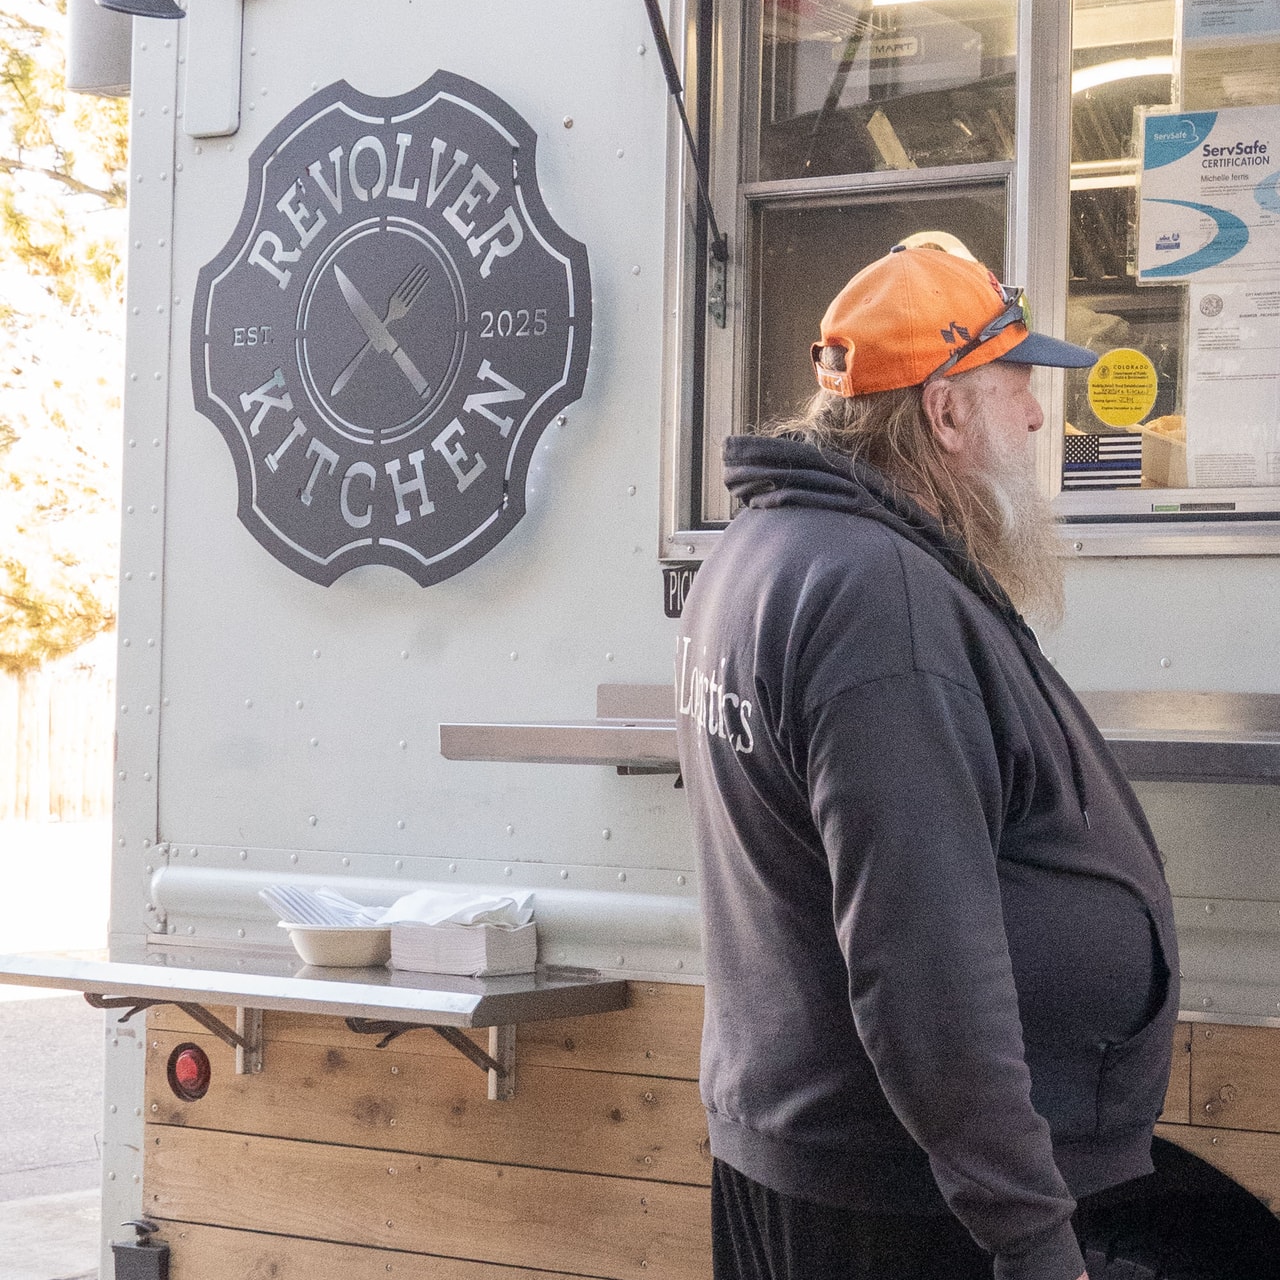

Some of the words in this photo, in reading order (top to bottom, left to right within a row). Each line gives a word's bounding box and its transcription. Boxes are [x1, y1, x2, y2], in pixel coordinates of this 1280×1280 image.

[1201, 156, 1270, 169] CERTIFICATION
[1202, 140, 1268, 157] ServSafe
[248, 131, 525, 290] REVOLVER
[233, 325, 275, 348] EST.
[479, 308, 549, 339] 2025
[239, 358, 527, 528] KITCHEN
